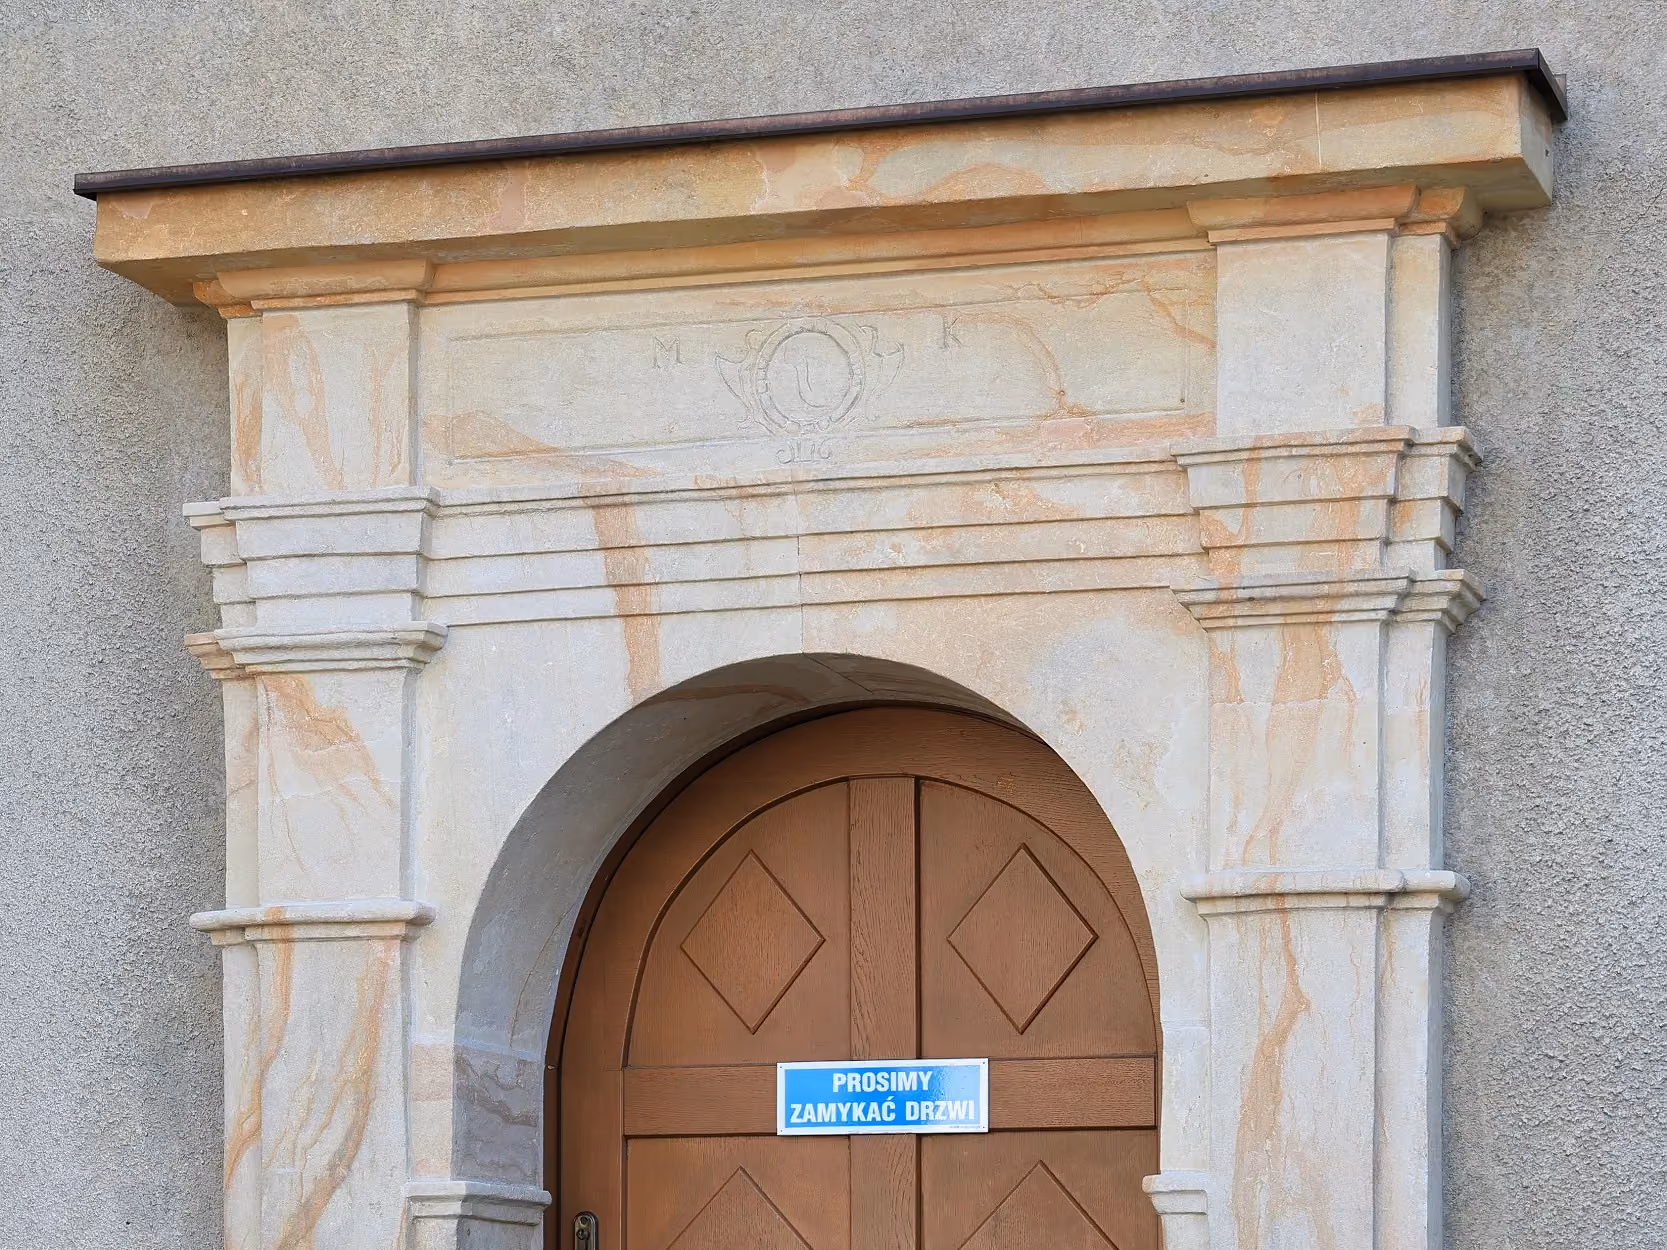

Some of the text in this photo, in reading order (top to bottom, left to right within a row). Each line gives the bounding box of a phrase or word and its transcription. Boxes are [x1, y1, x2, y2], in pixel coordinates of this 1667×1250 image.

[650, 314, 964, 368] M K
[832, 1071, 933, 1093] PROSIMY
[790, 1096, 975, 1123] ZAMYKAĆ DRZWI
